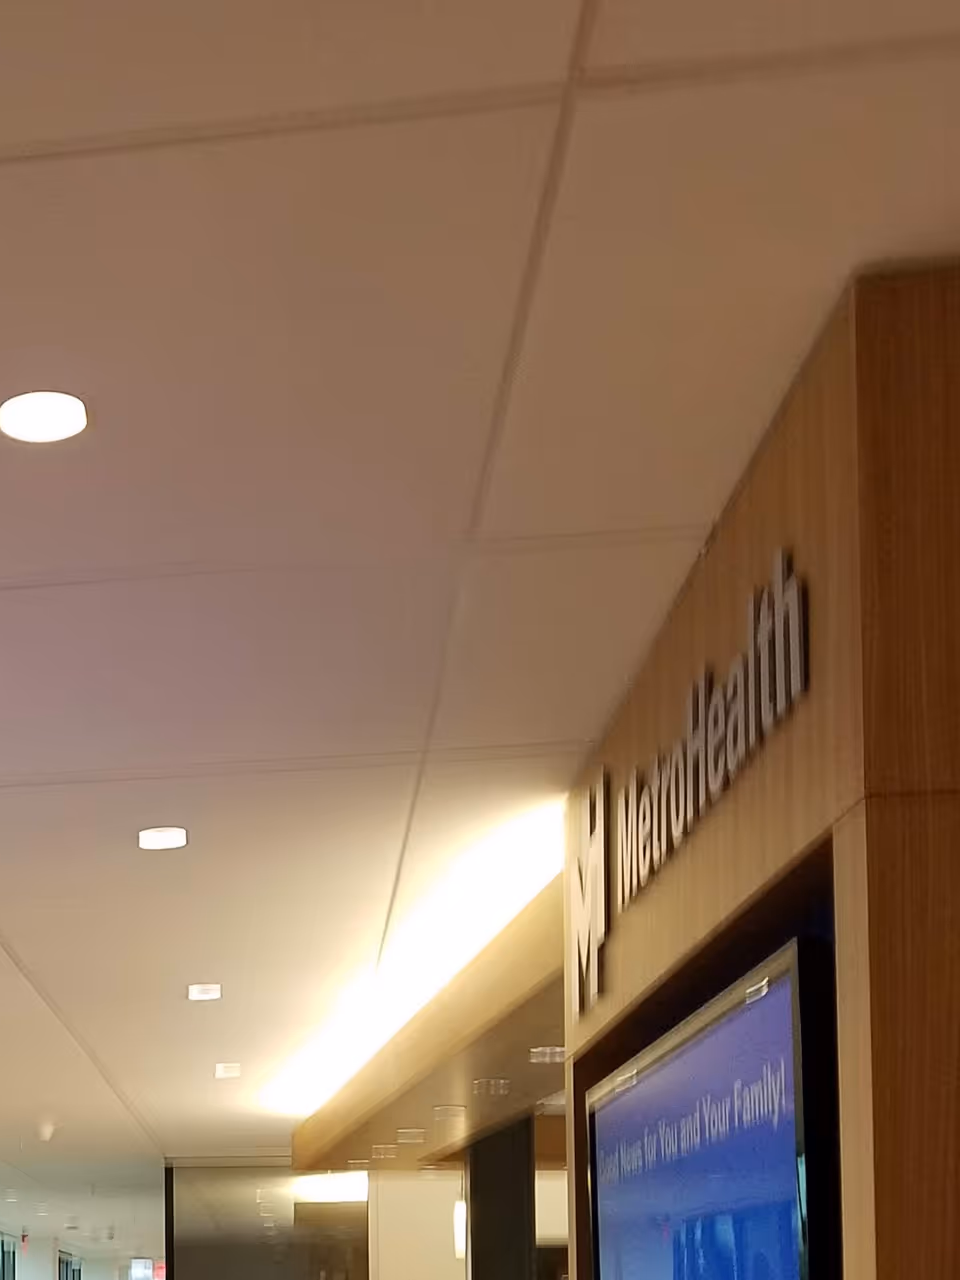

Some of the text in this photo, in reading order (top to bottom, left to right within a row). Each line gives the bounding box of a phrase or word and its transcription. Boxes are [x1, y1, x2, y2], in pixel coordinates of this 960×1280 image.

[617, 547, 808, 911] MetroHealth
[644, 1126, 657, 1171] for
[659, 1118, 677, 1161] You
[681, 1100, 700, 1155] and
[702, 1094, 730, 1144] Your
[733, 1056, 785, 1132] Family!
